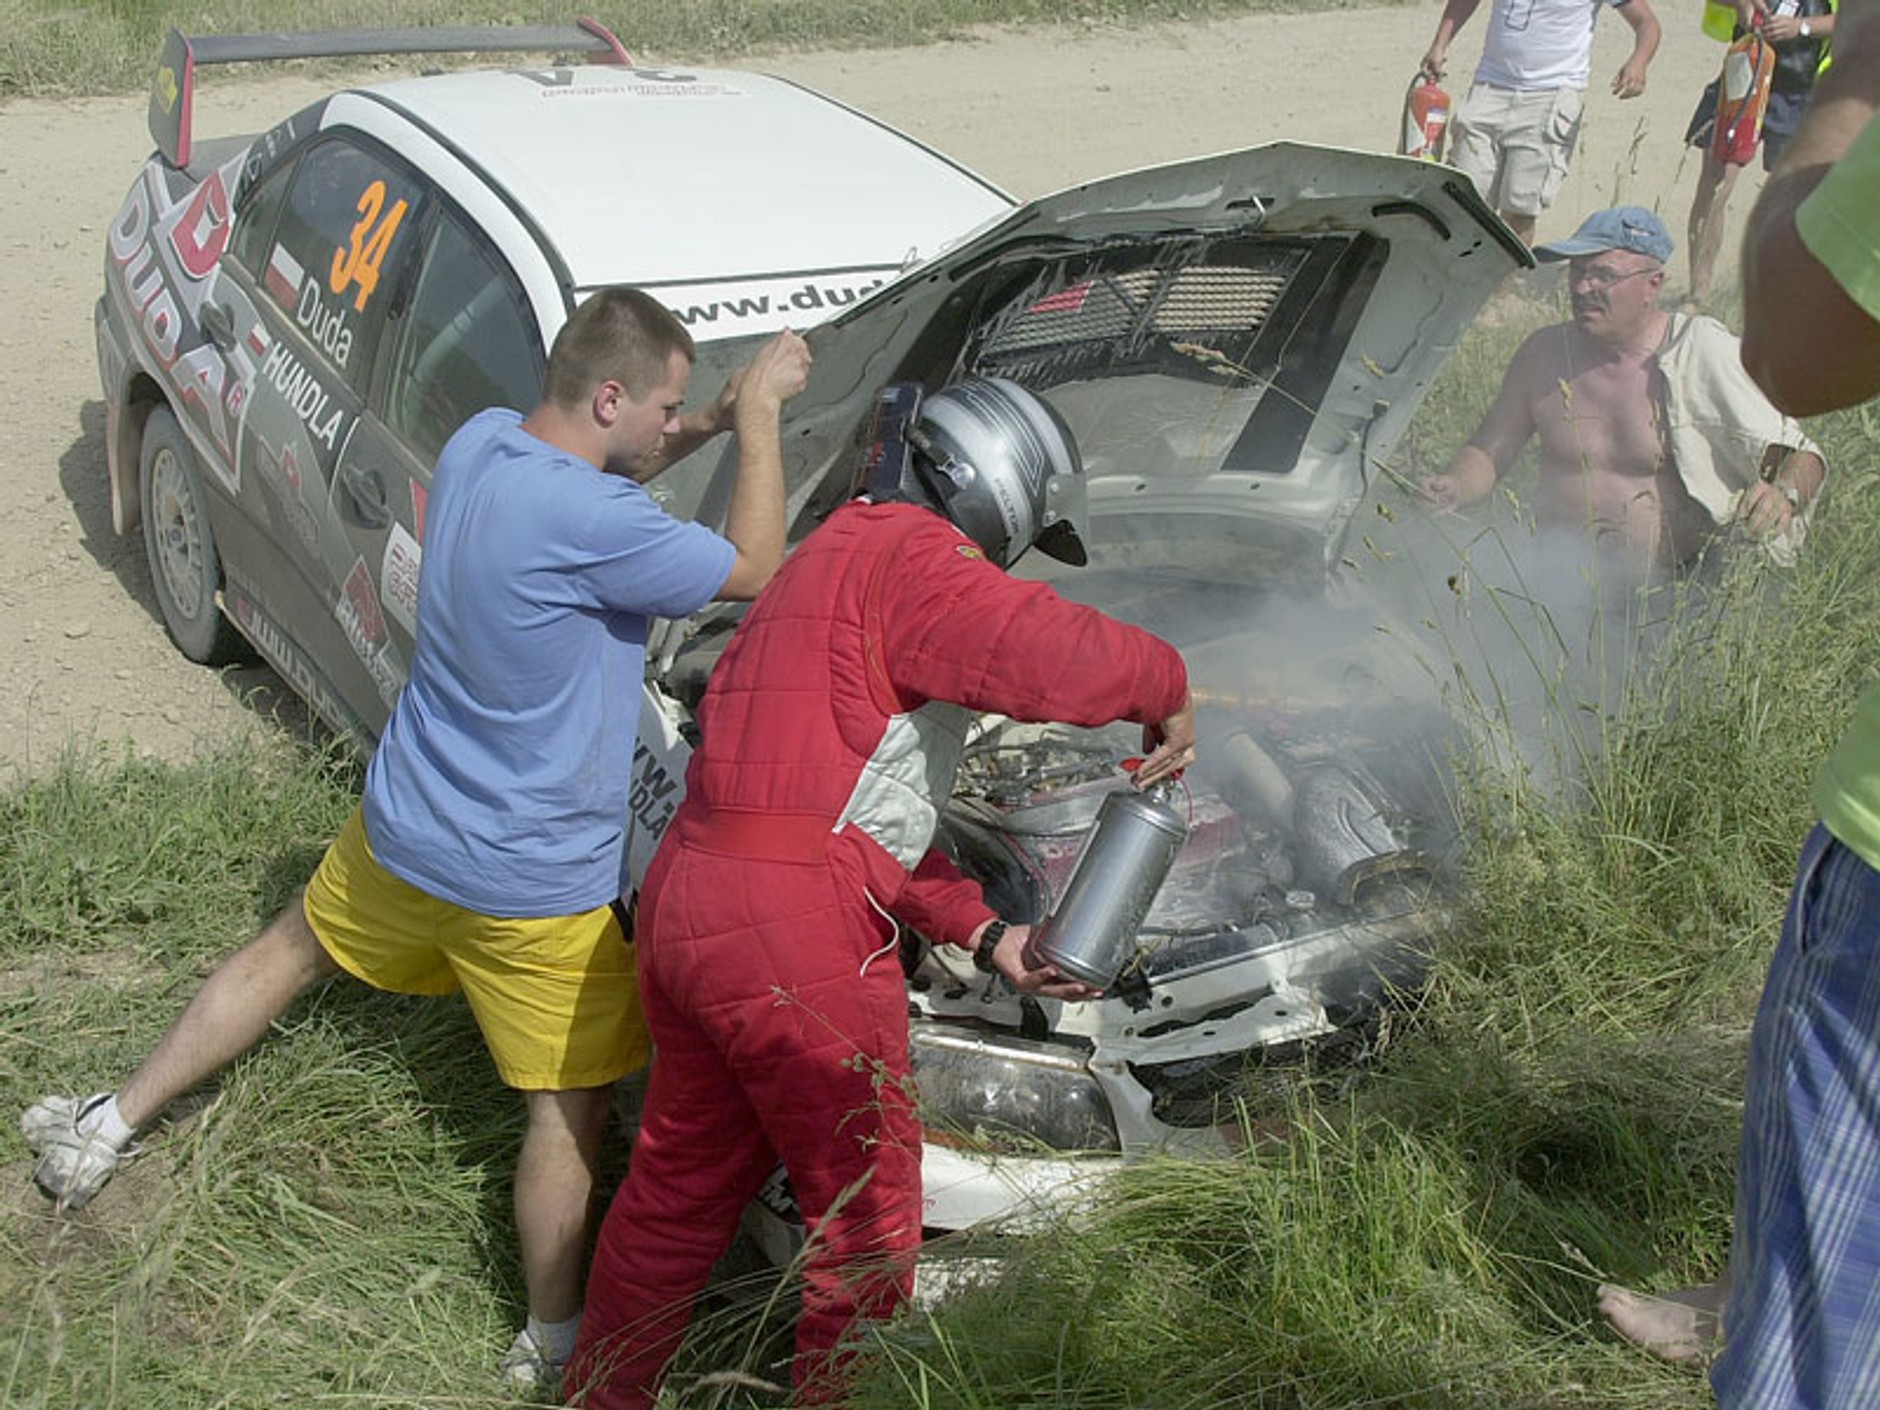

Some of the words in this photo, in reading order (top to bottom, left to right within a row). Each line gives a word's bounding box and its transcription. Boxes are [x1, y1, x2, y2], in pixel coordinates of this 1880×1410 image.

[329, 180, 409, 312] 34
[295, 276, 354, 369] Duda
[262, 342, 345, 451] HUNDLA
